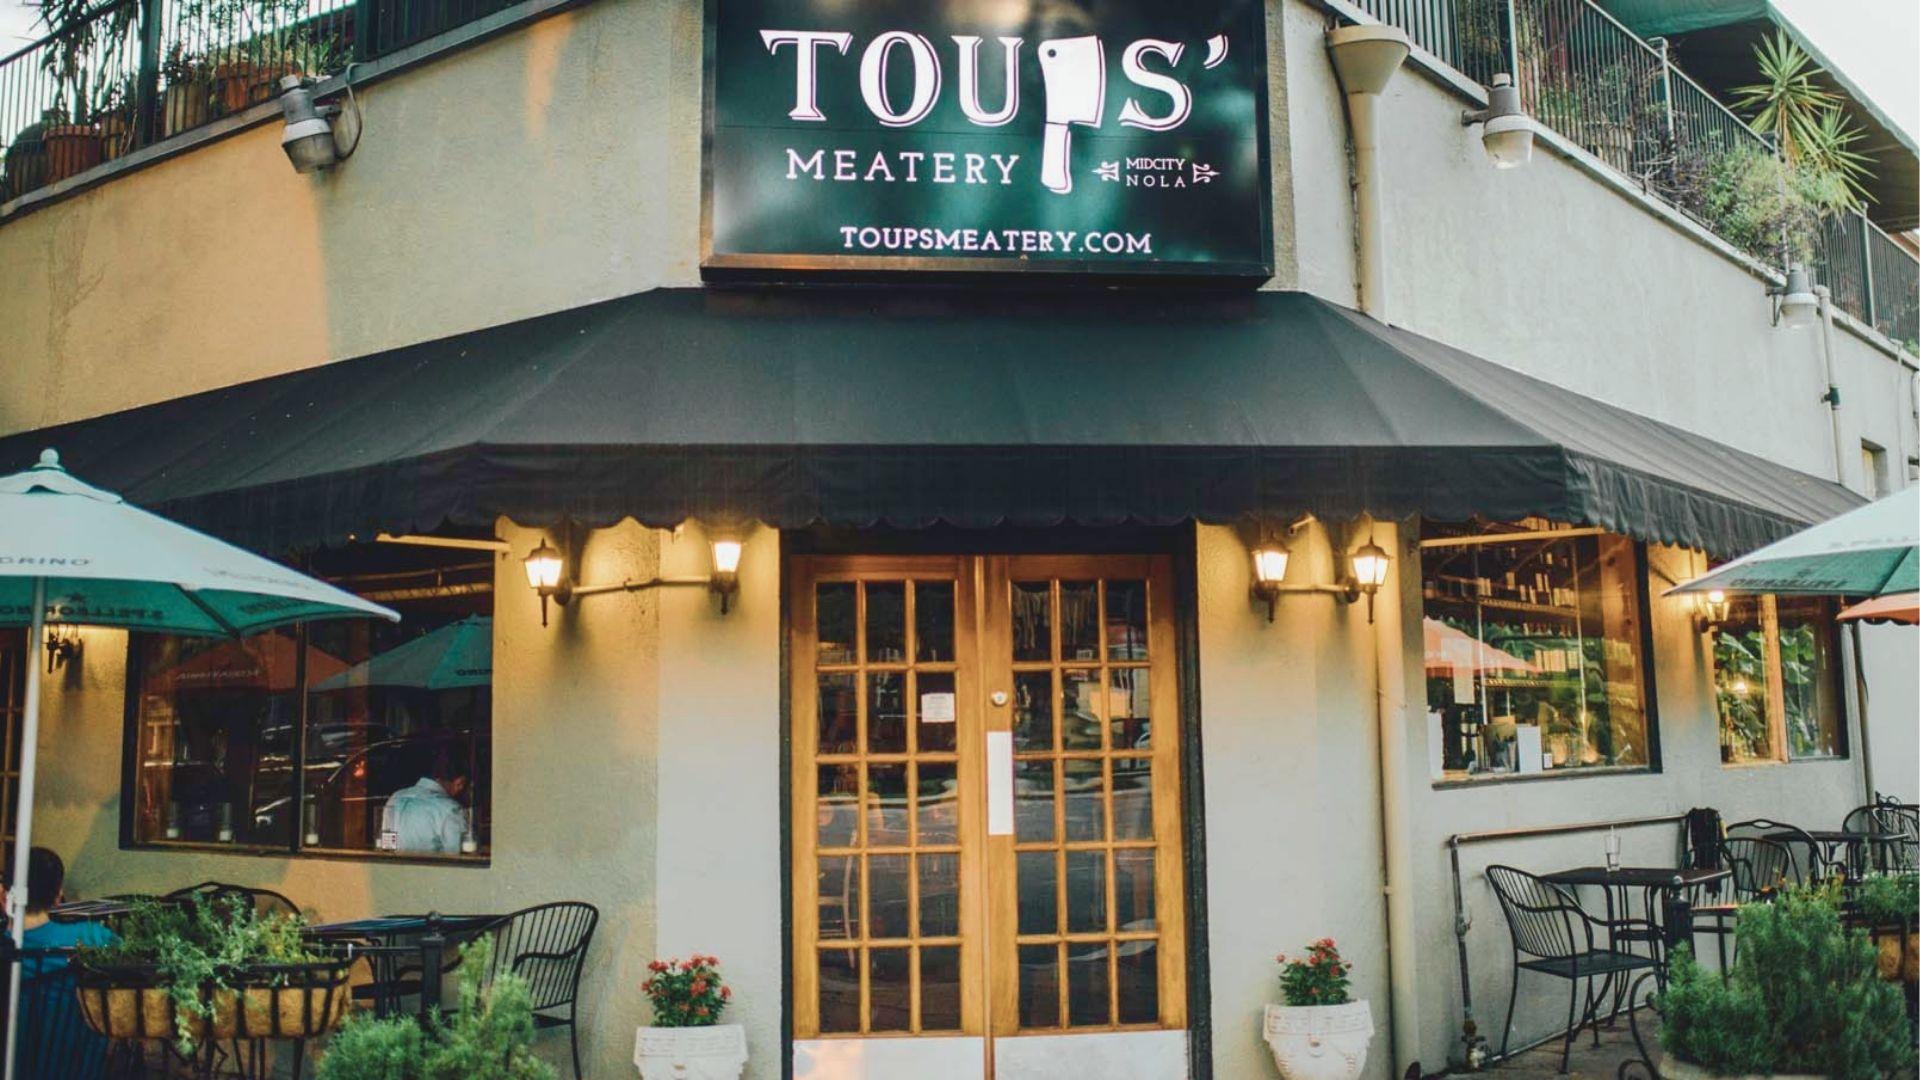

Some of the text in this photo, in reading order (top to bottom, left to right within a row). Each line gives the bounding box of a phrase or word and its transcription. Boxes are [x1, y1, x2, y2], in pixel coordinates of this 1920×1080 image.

[786, 149, 1020, 185] MEATERY
[1126, 157, 1186, 171] MIDCITY
[1126, 175, 1186, 188] NOLA
[840, 226, 1152, 254] TOUPSMEATERY.COM
